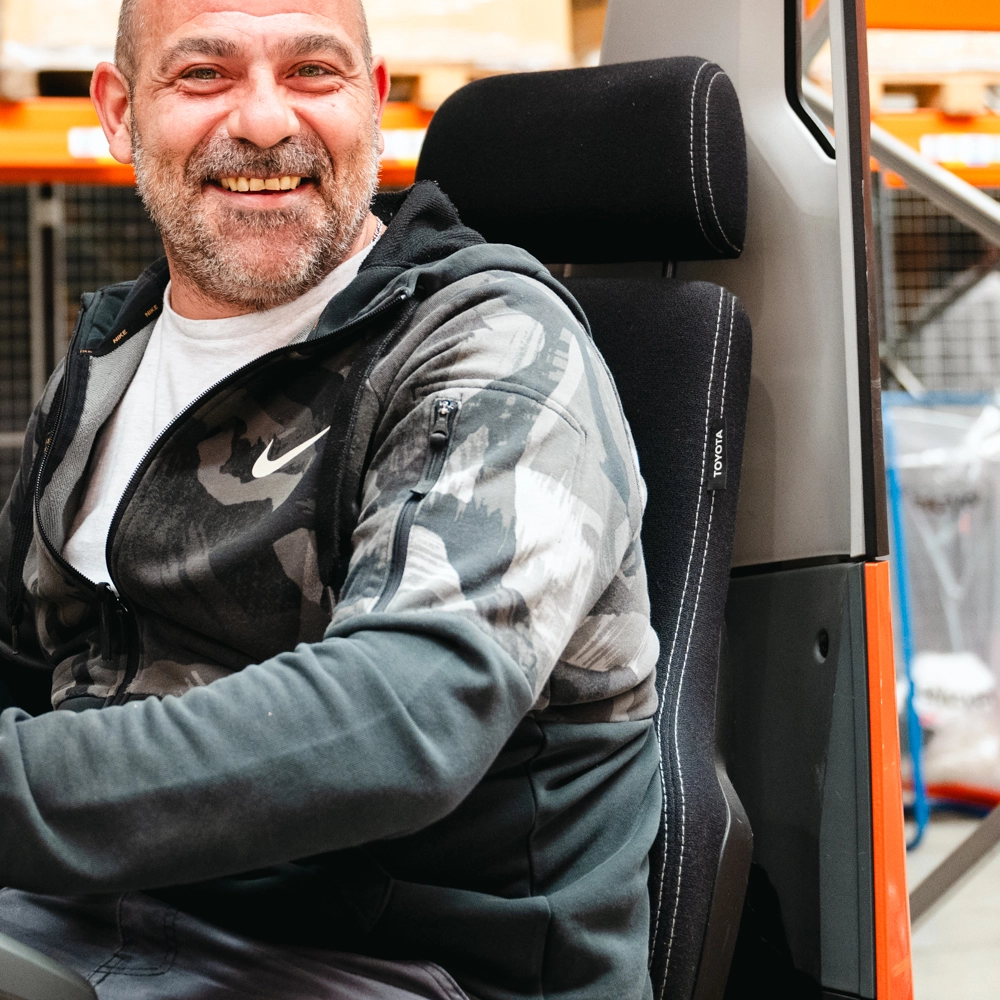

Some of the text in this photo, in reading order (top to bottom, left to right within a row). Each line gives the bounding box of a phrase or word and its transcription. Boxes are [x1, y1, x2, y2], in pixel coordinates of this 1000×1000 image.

[144, 304, 159, 318] NIKE
[112, 329, 128, 344] NIKE
[713, 429, 723, 478] TOYOTA
